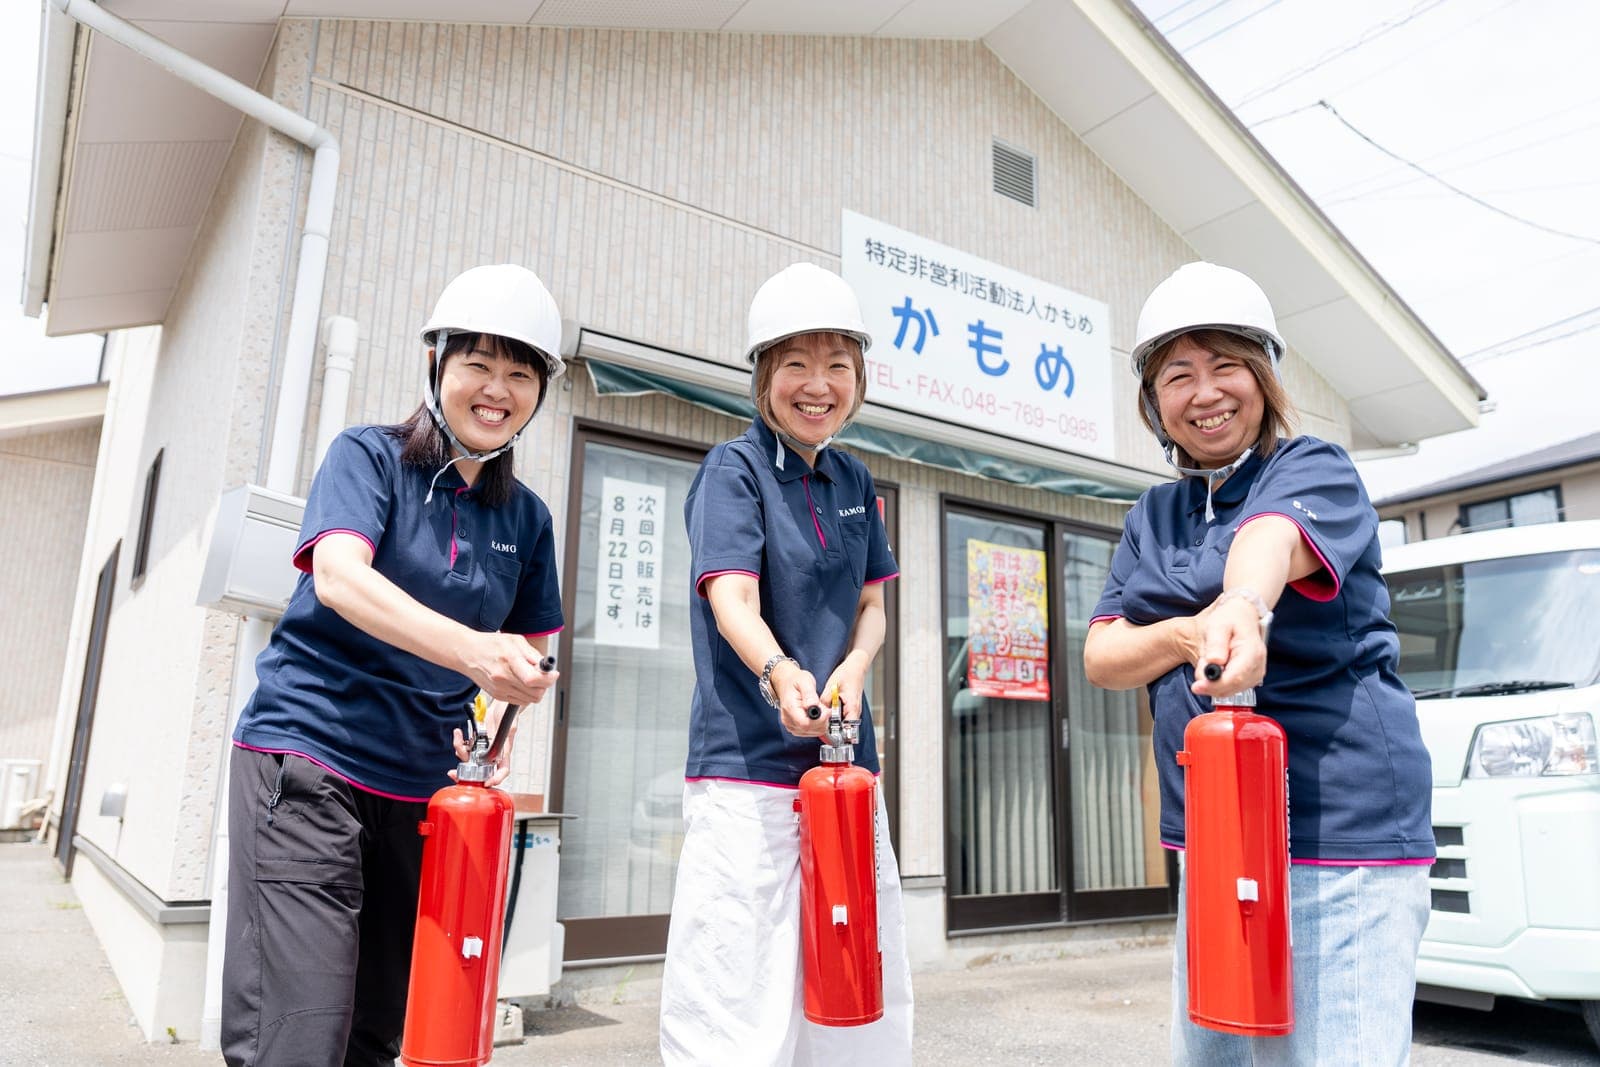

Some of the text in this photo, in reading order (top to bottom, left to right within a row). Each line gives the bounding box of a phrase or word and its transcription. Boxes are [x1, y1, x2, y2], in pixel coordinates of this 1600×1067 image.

[865, 237, 1094, 335] 特定非営利活動法人かもめ
[891, 296, 1077, 400] かもめ
[636, 496, 657, 629] 次回の販売は
